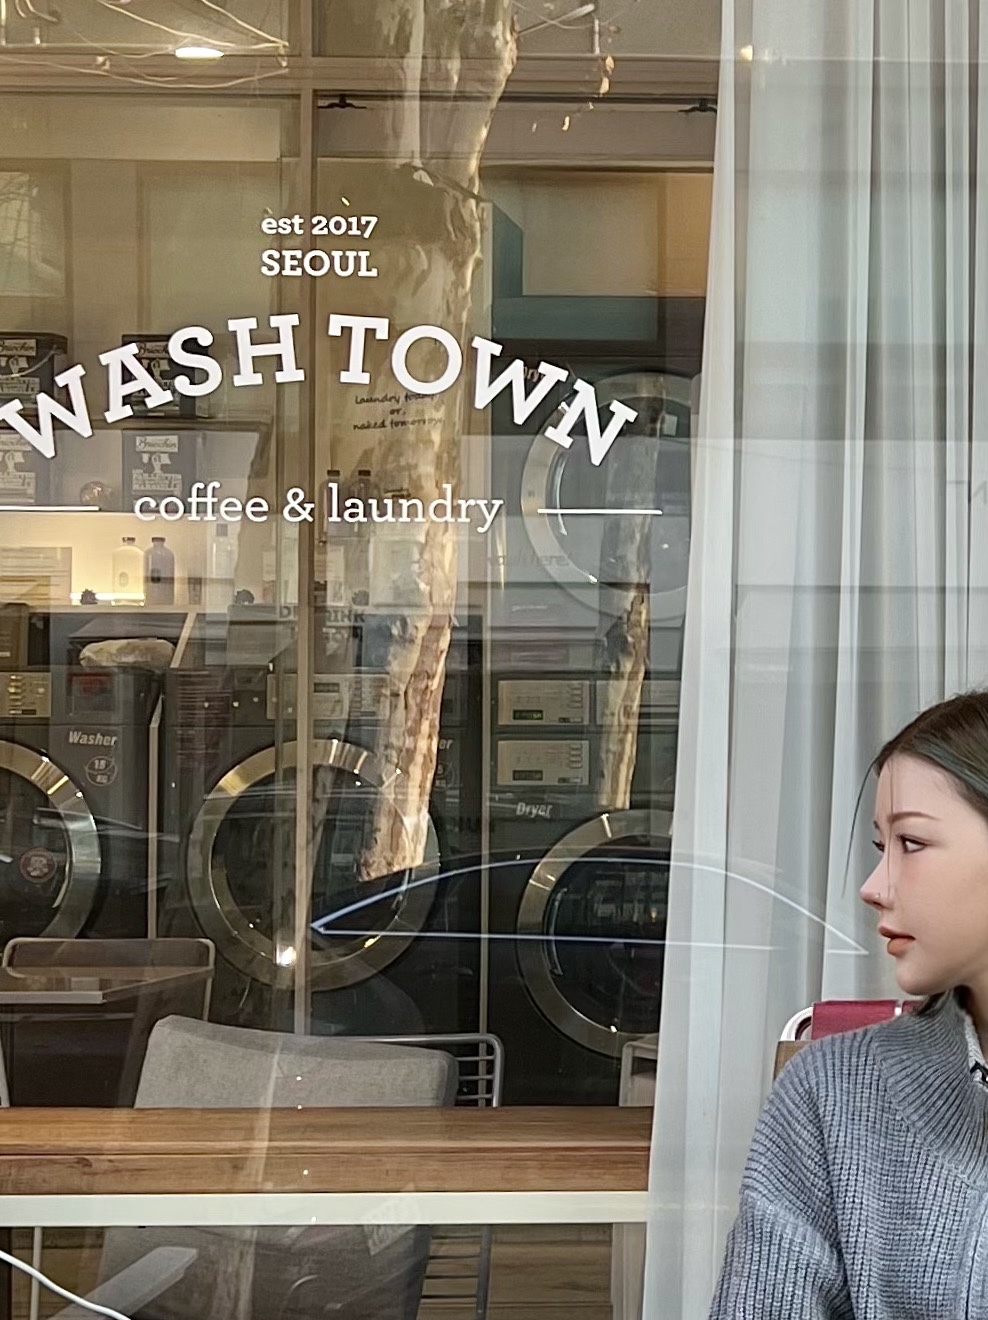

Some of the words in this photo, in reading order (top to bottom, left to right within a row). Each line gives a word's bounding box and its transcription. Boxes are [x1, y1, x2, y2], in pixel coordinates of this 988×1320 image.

[261, 214, 305, 235] est
[311, 215, 379, 239] 2017
[260, 249, 379, 277] SEOUL
[0, 313, 306, 459] WASH
[328, 313, 639, 467] TOWN
[133, 481, 270, 523] coffee
[281, 487, 316, 523] &
[327, 482, 504, 533] laundry
[68, 730, 119, 746] Washer
[515, 801, 553, 818] Dryer
